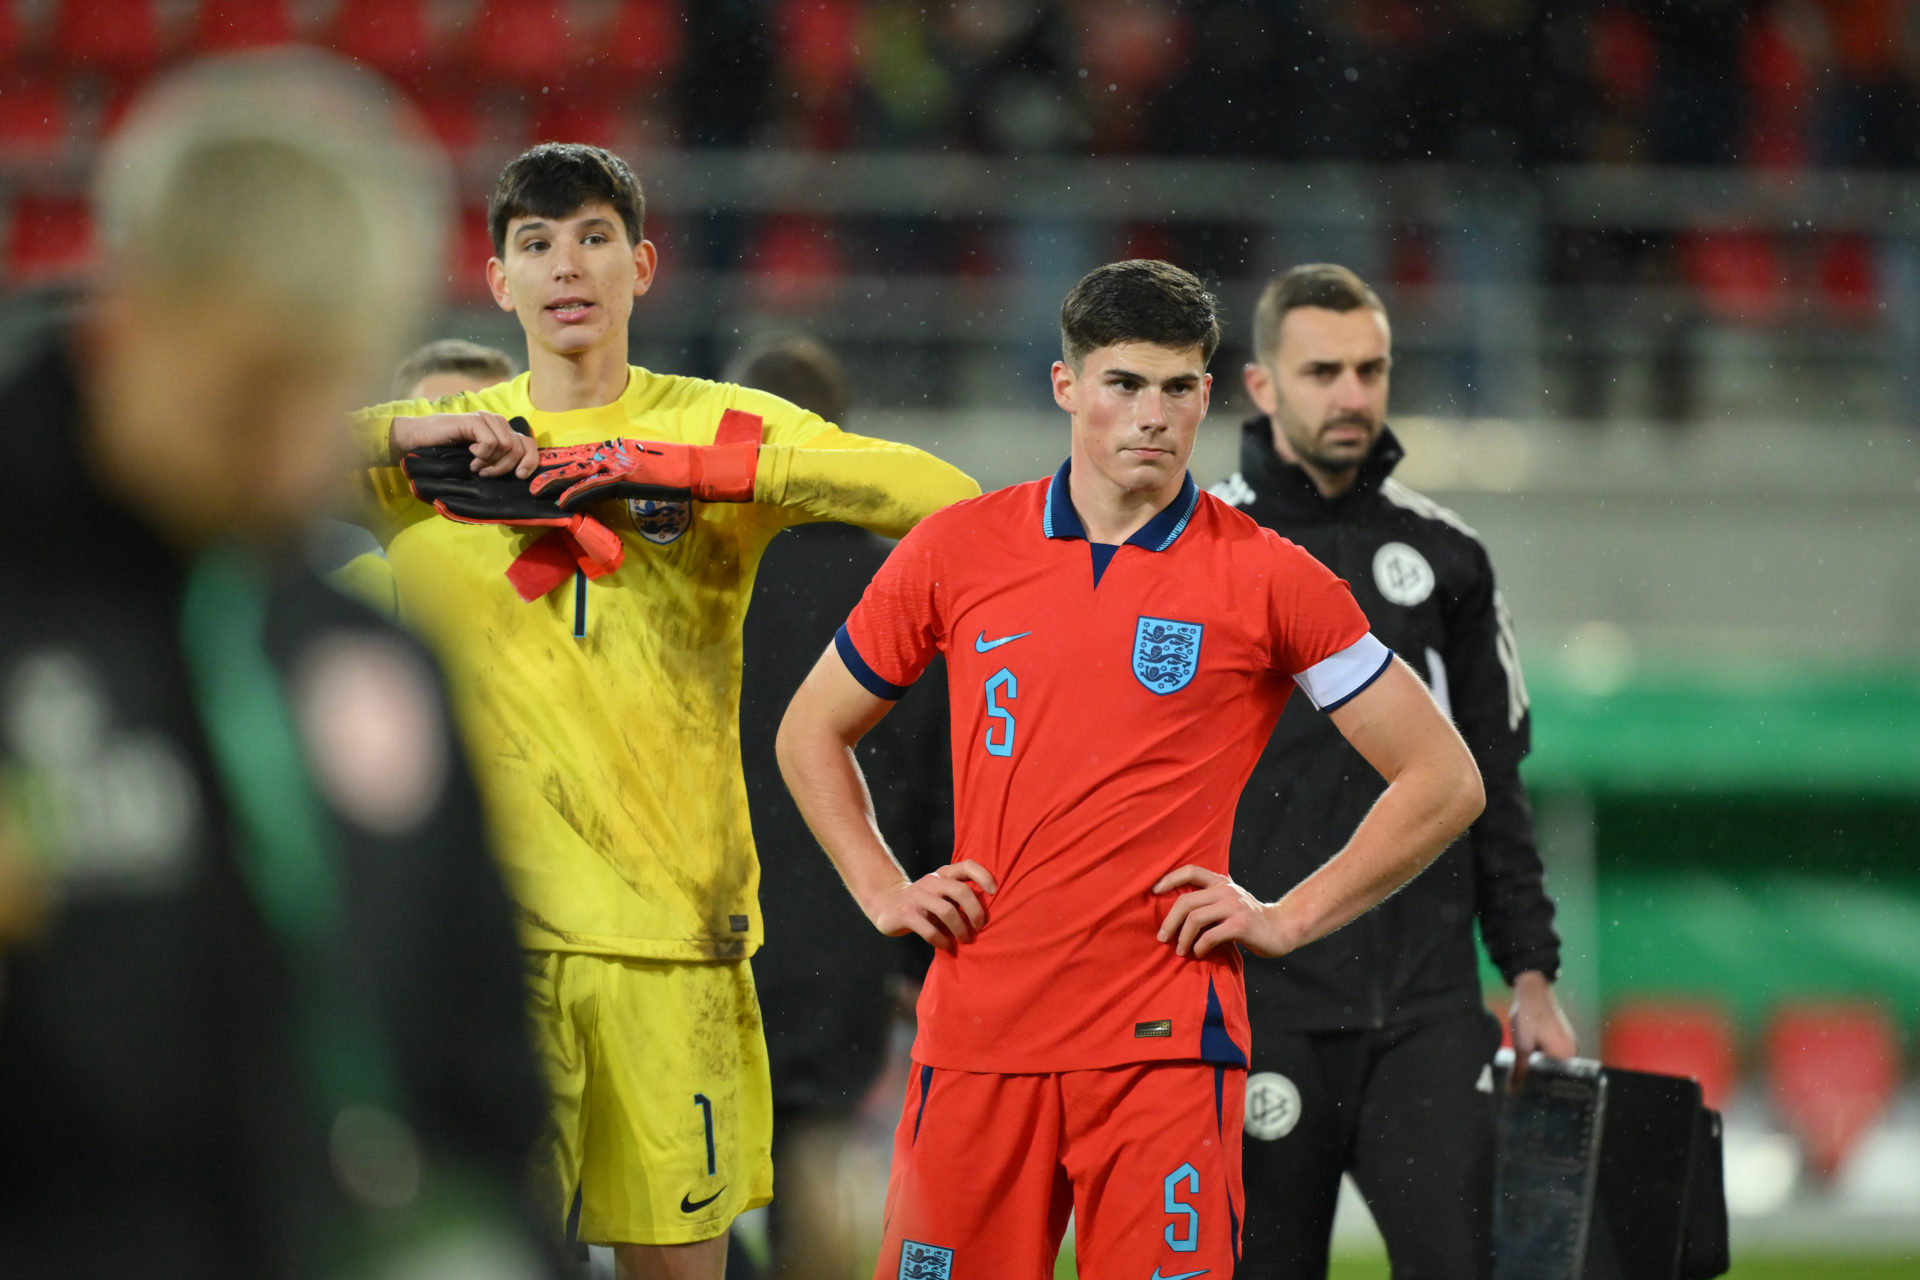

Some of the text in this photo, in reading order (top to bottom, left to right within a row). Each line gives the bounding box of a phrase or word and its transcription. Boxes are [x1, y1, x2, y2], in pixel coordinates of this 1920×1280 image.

[984, 666, 1018, 758] 5
[693, 1093, 716, 1176] 1
[1164, 1162, 1200, 1252] 5
